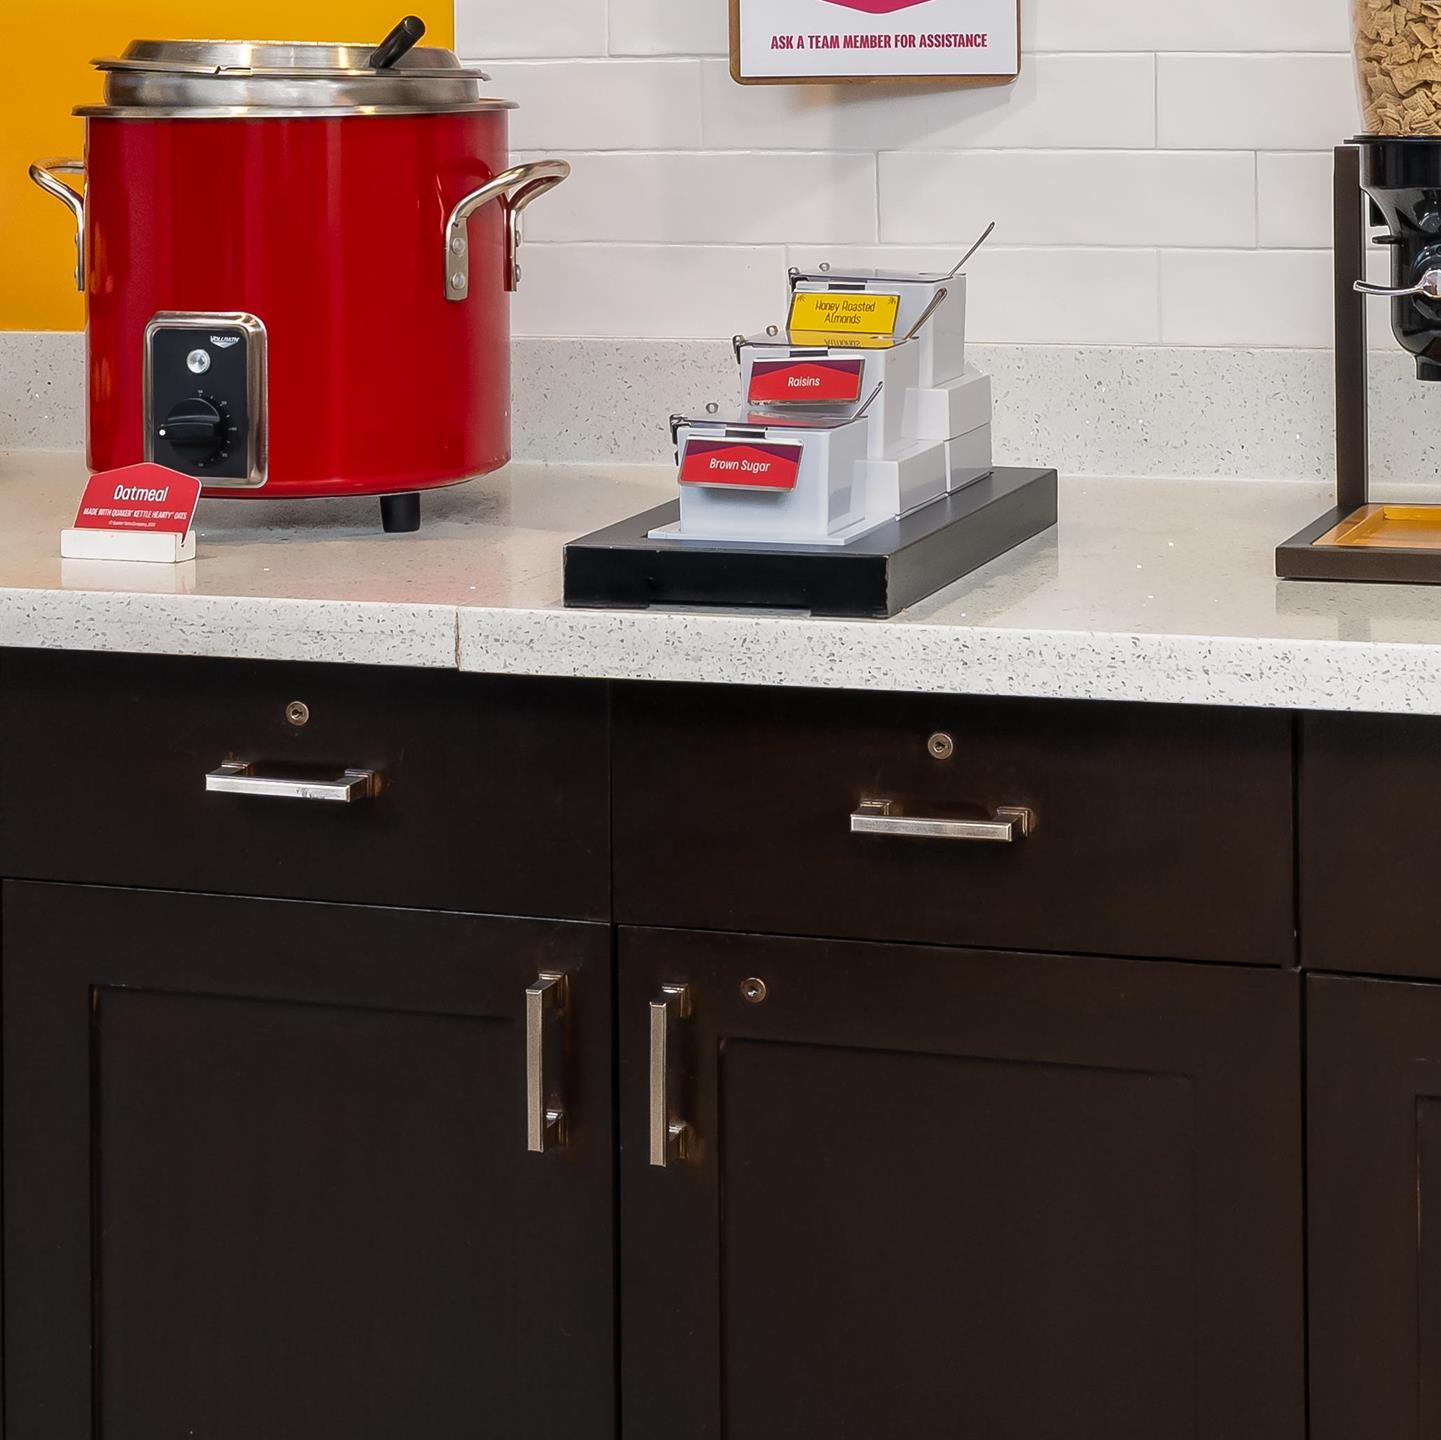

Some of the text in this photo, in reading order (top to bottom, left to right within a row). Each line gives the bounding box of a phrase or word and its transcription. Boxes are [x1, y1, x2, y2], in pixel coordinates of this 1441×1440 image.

[770, 33, 988, 50] ASK A TEAM MEMBER FOR ASSISTANCE
[815, 300, 876, 316] Honey Roasted
[824, 312, 862, 324] Almonds
[788, 376, 820, 387] Raisins
[709, 458, 771, 473] Brown Sugar
[113, 484, 169, 502] Oatmeal
